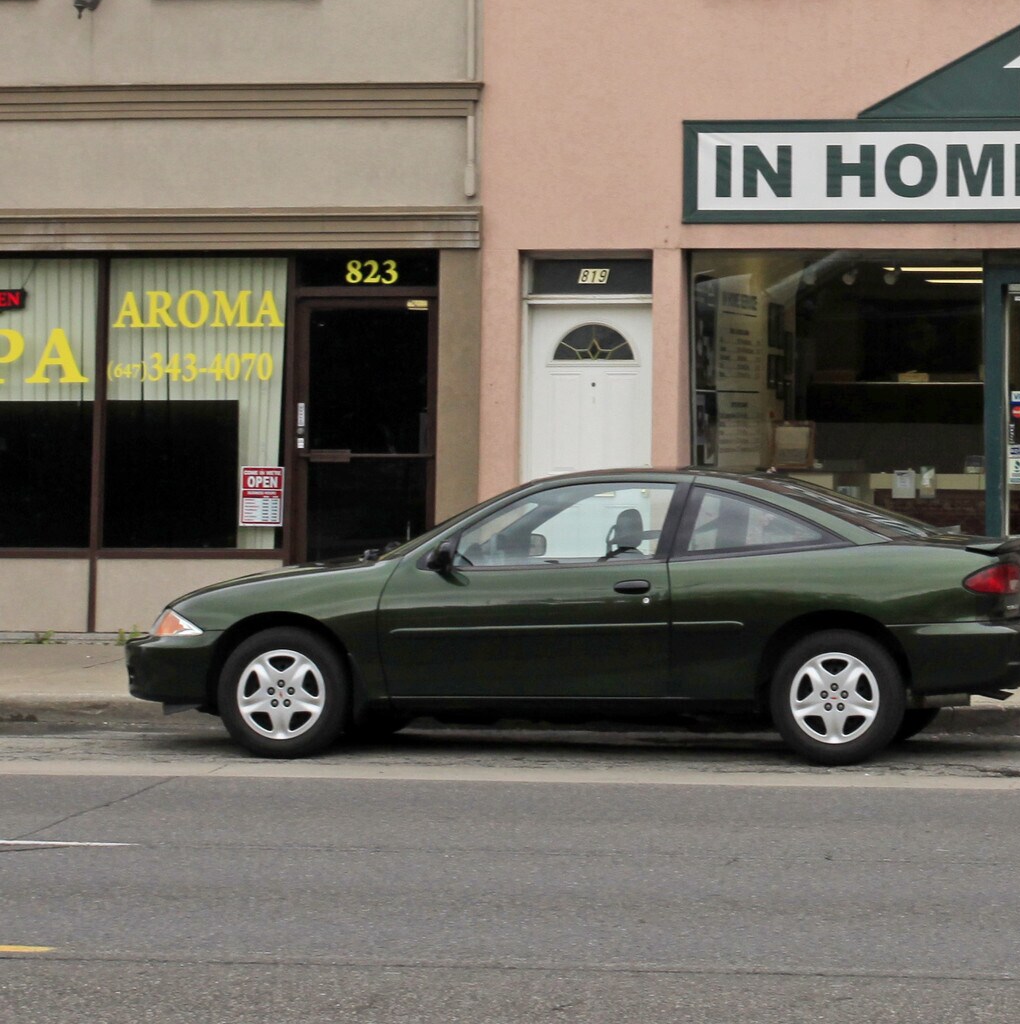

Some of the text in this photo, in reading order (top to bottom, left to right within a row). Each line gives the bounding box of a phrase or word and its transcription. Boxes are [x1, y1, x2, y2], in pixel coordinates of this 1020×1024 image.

[715, 145, 792, 198] IN
[345, 259, 398, 284] 823
[581, 269, 608, 283] 819
[112, 289, 284, 328] AROMA
[247, 476, 279, 488] OPEN
